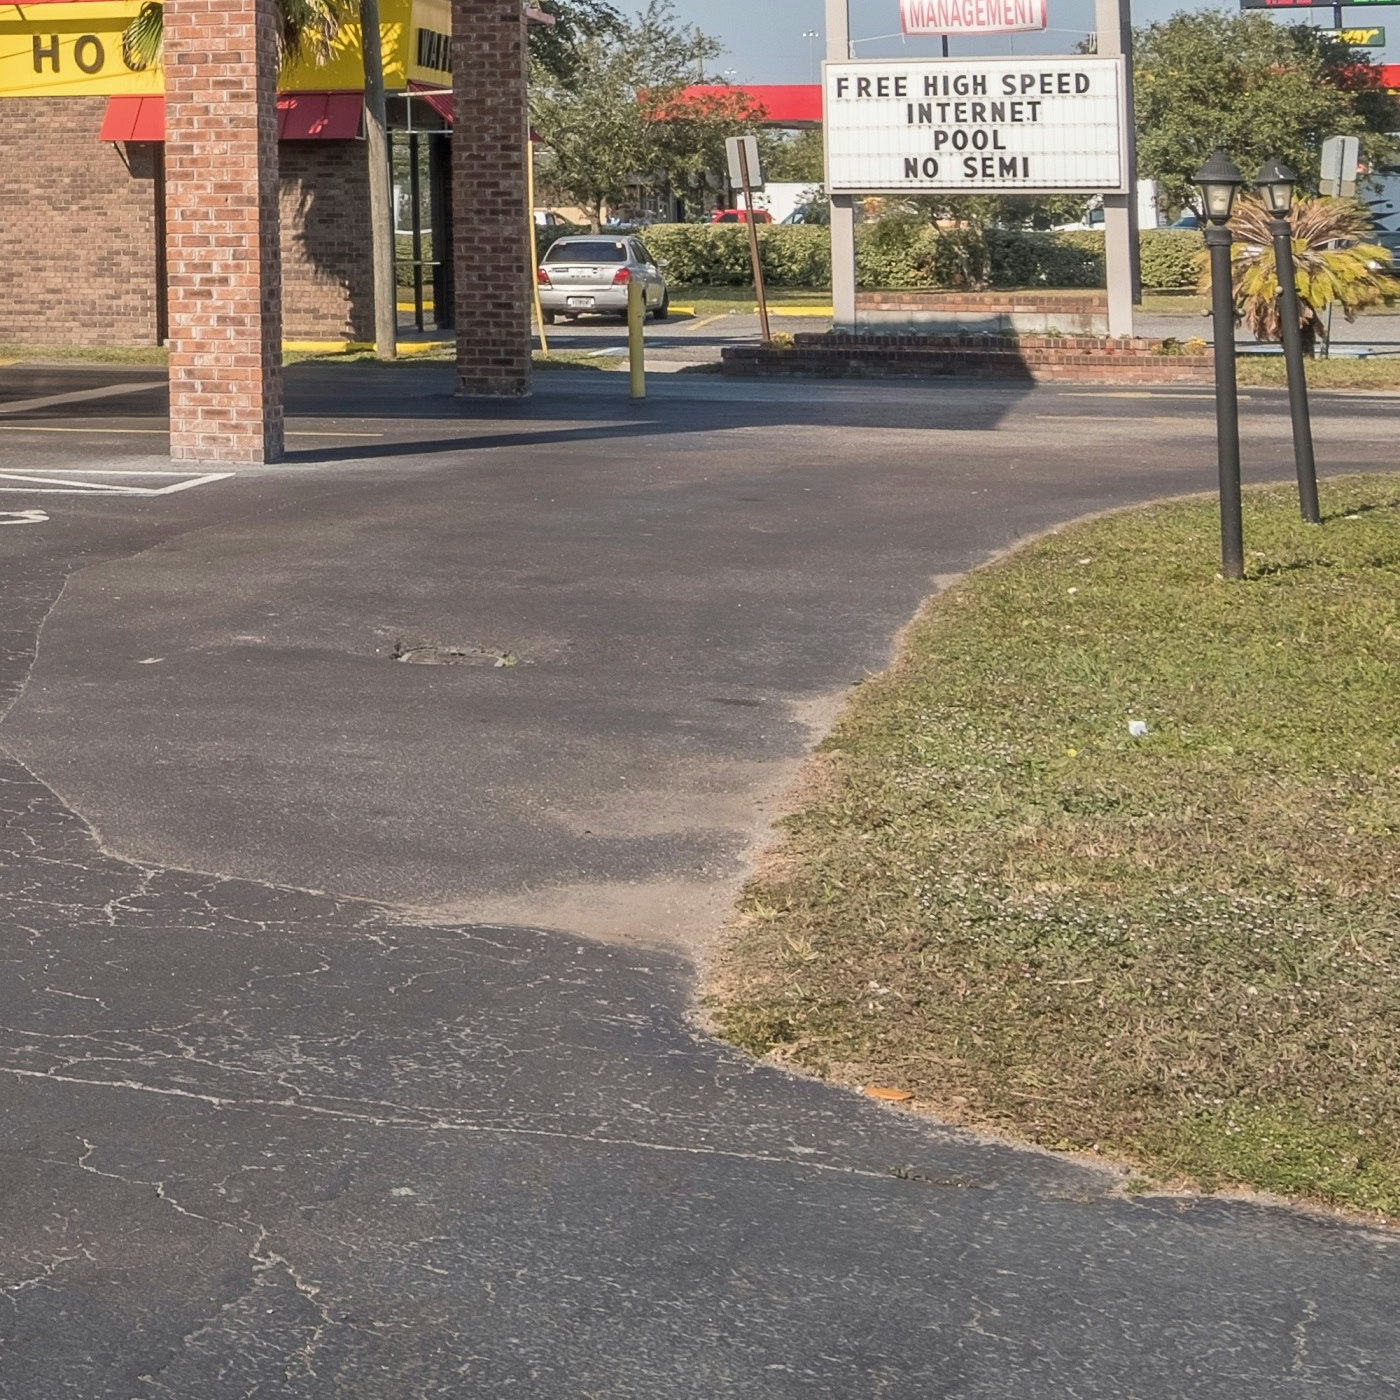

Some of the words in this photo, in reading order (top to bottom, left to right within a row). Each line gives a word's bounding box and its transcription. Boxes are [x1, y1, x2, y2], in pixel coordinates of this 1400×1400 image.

[836, 76, 908, 98] FREE
[923, 74, 987, 97] HIGH
[1002, 72, 1091, 96] SPEED
[906, 101, 1042, 124] INTERNET
[933, 129, 1007, 151] POOL
[903, 157, 940, 179] NO
[963, 157, 1030, 179] SEMI
